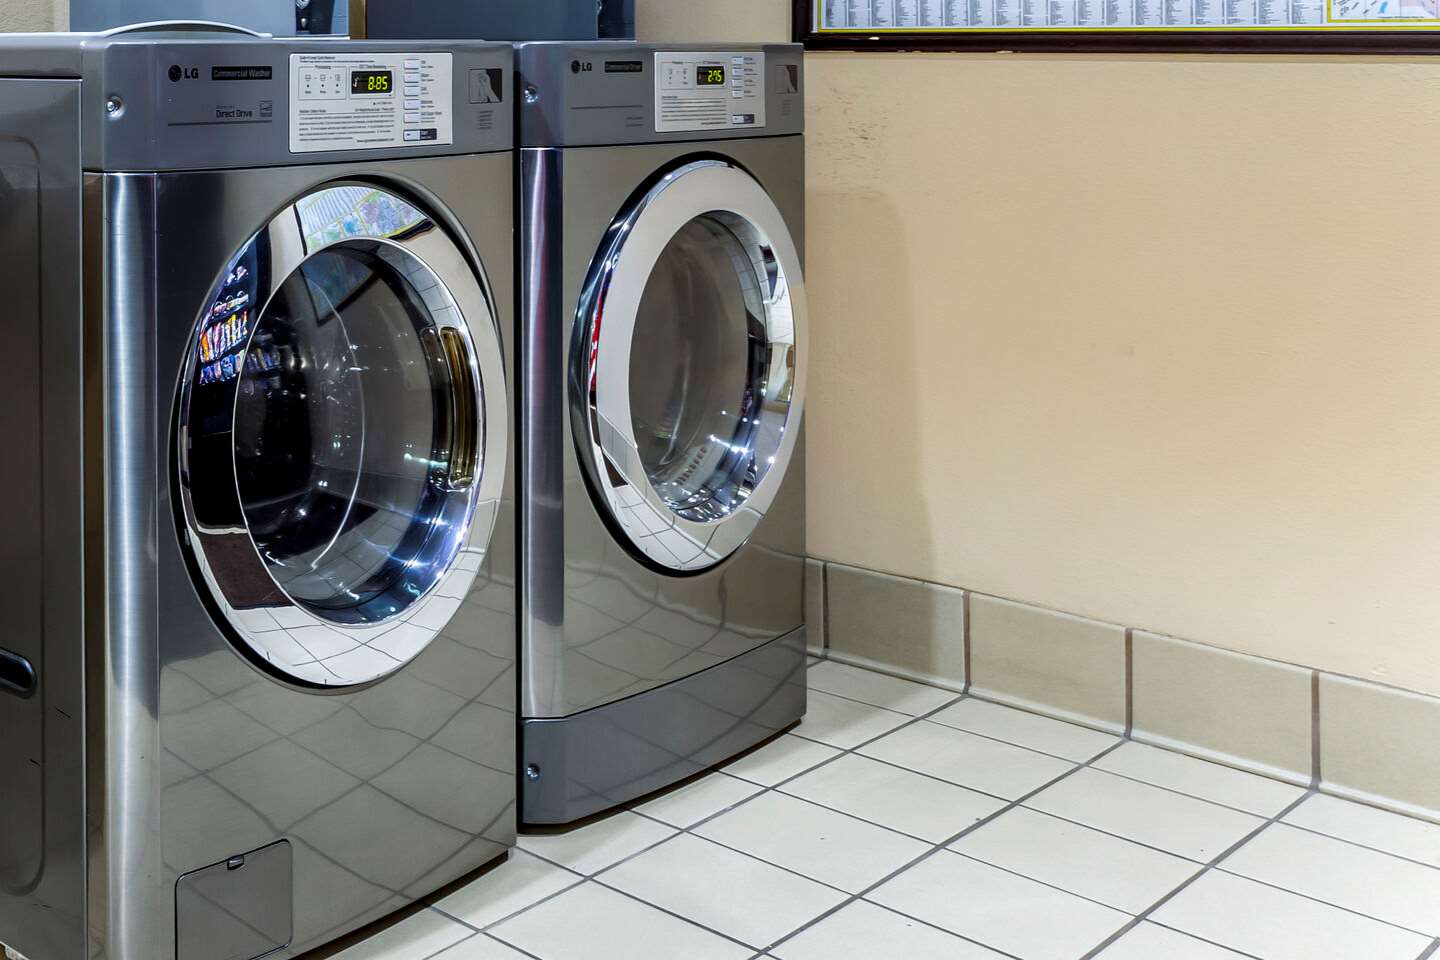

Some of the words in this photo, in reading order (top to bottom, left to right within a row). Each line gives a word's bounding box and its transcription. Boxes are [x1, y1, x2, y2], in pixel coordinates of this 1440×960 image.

[582, 62, 593, 71] LG
[184, 68, 199, 79] LG
[216, 109, 236, 118] Direct
[236, 109, 253, 118] Drive
